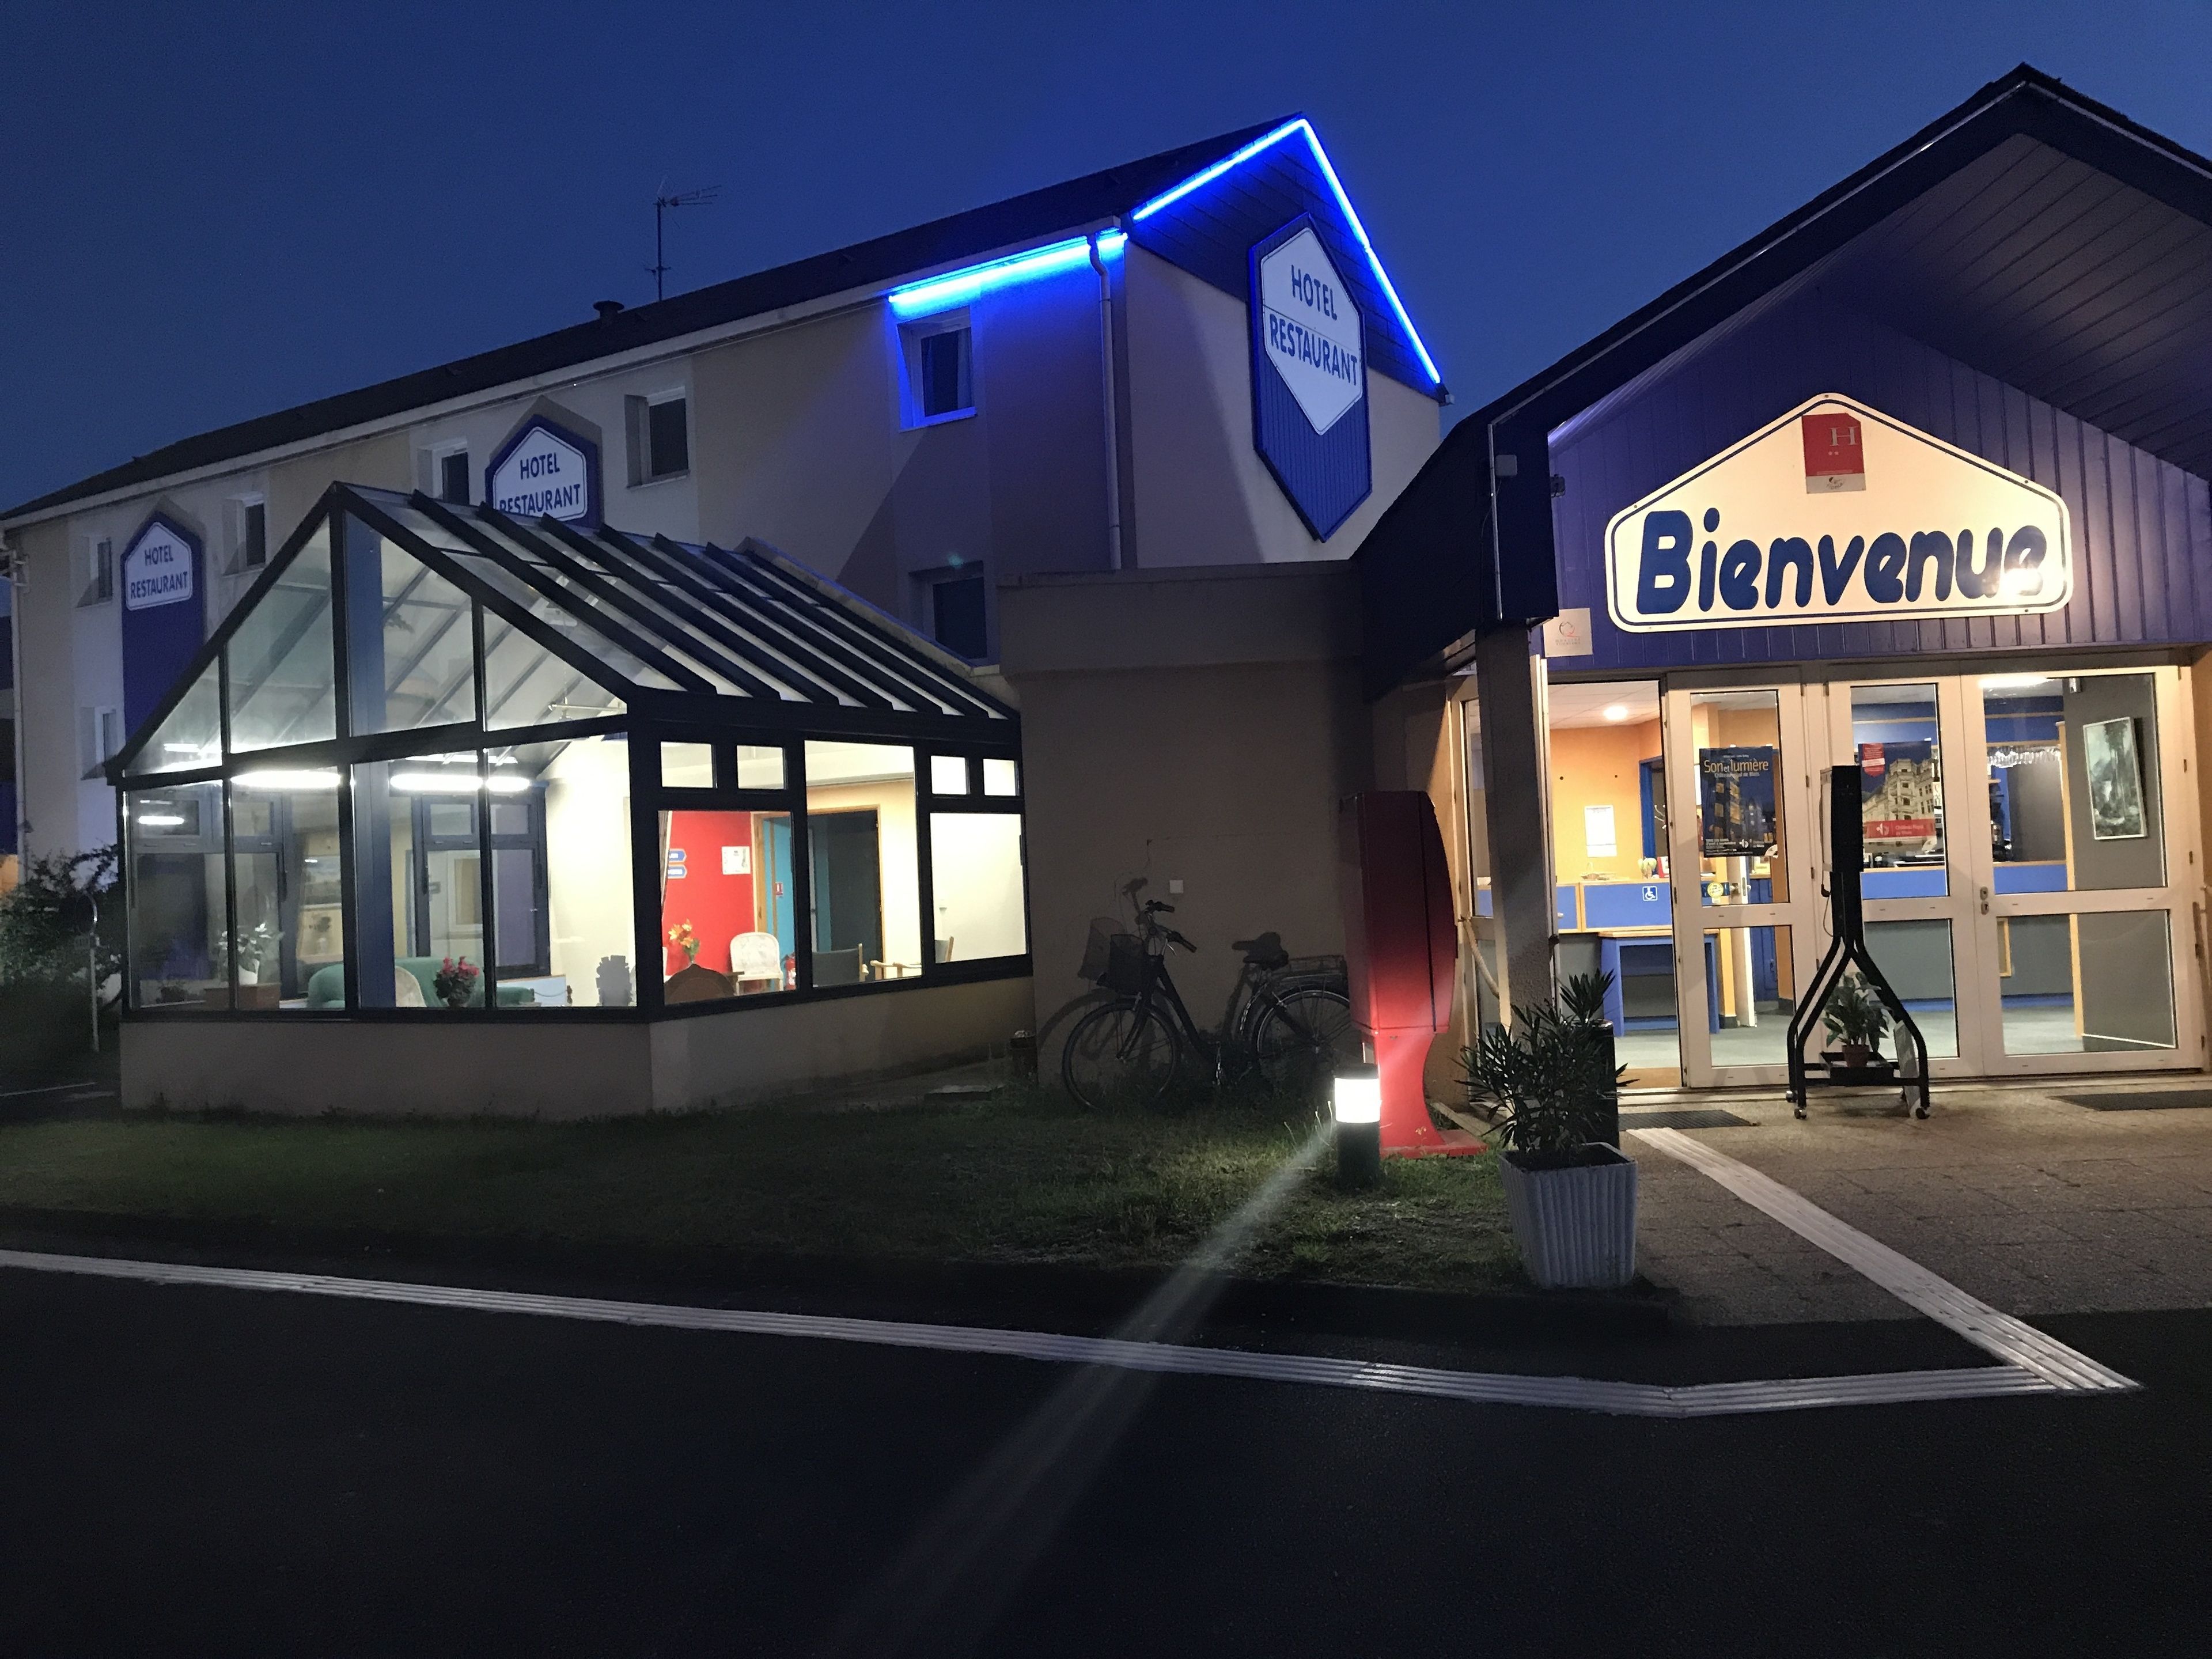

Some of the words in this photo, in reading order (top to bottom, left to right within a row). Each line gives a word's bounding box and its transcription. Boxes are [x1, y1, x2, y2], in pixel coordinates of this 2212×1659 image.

[1291, 264, 1338, 321] HOTEL
[1270, 314, 1358, 386] RESTAURANT
[1828, 426, 1858, 446] H
[520, 452, 560, 480] HOTEL
[144, 544, 174, 566] HOTEL
[1636, 507, 2047, 614] Bienvenue
[130, 571, 188, 600] RESTAURANT
[1703, 760, 1724, 773] Son
[1729, 758, 1769, 772] lumière
